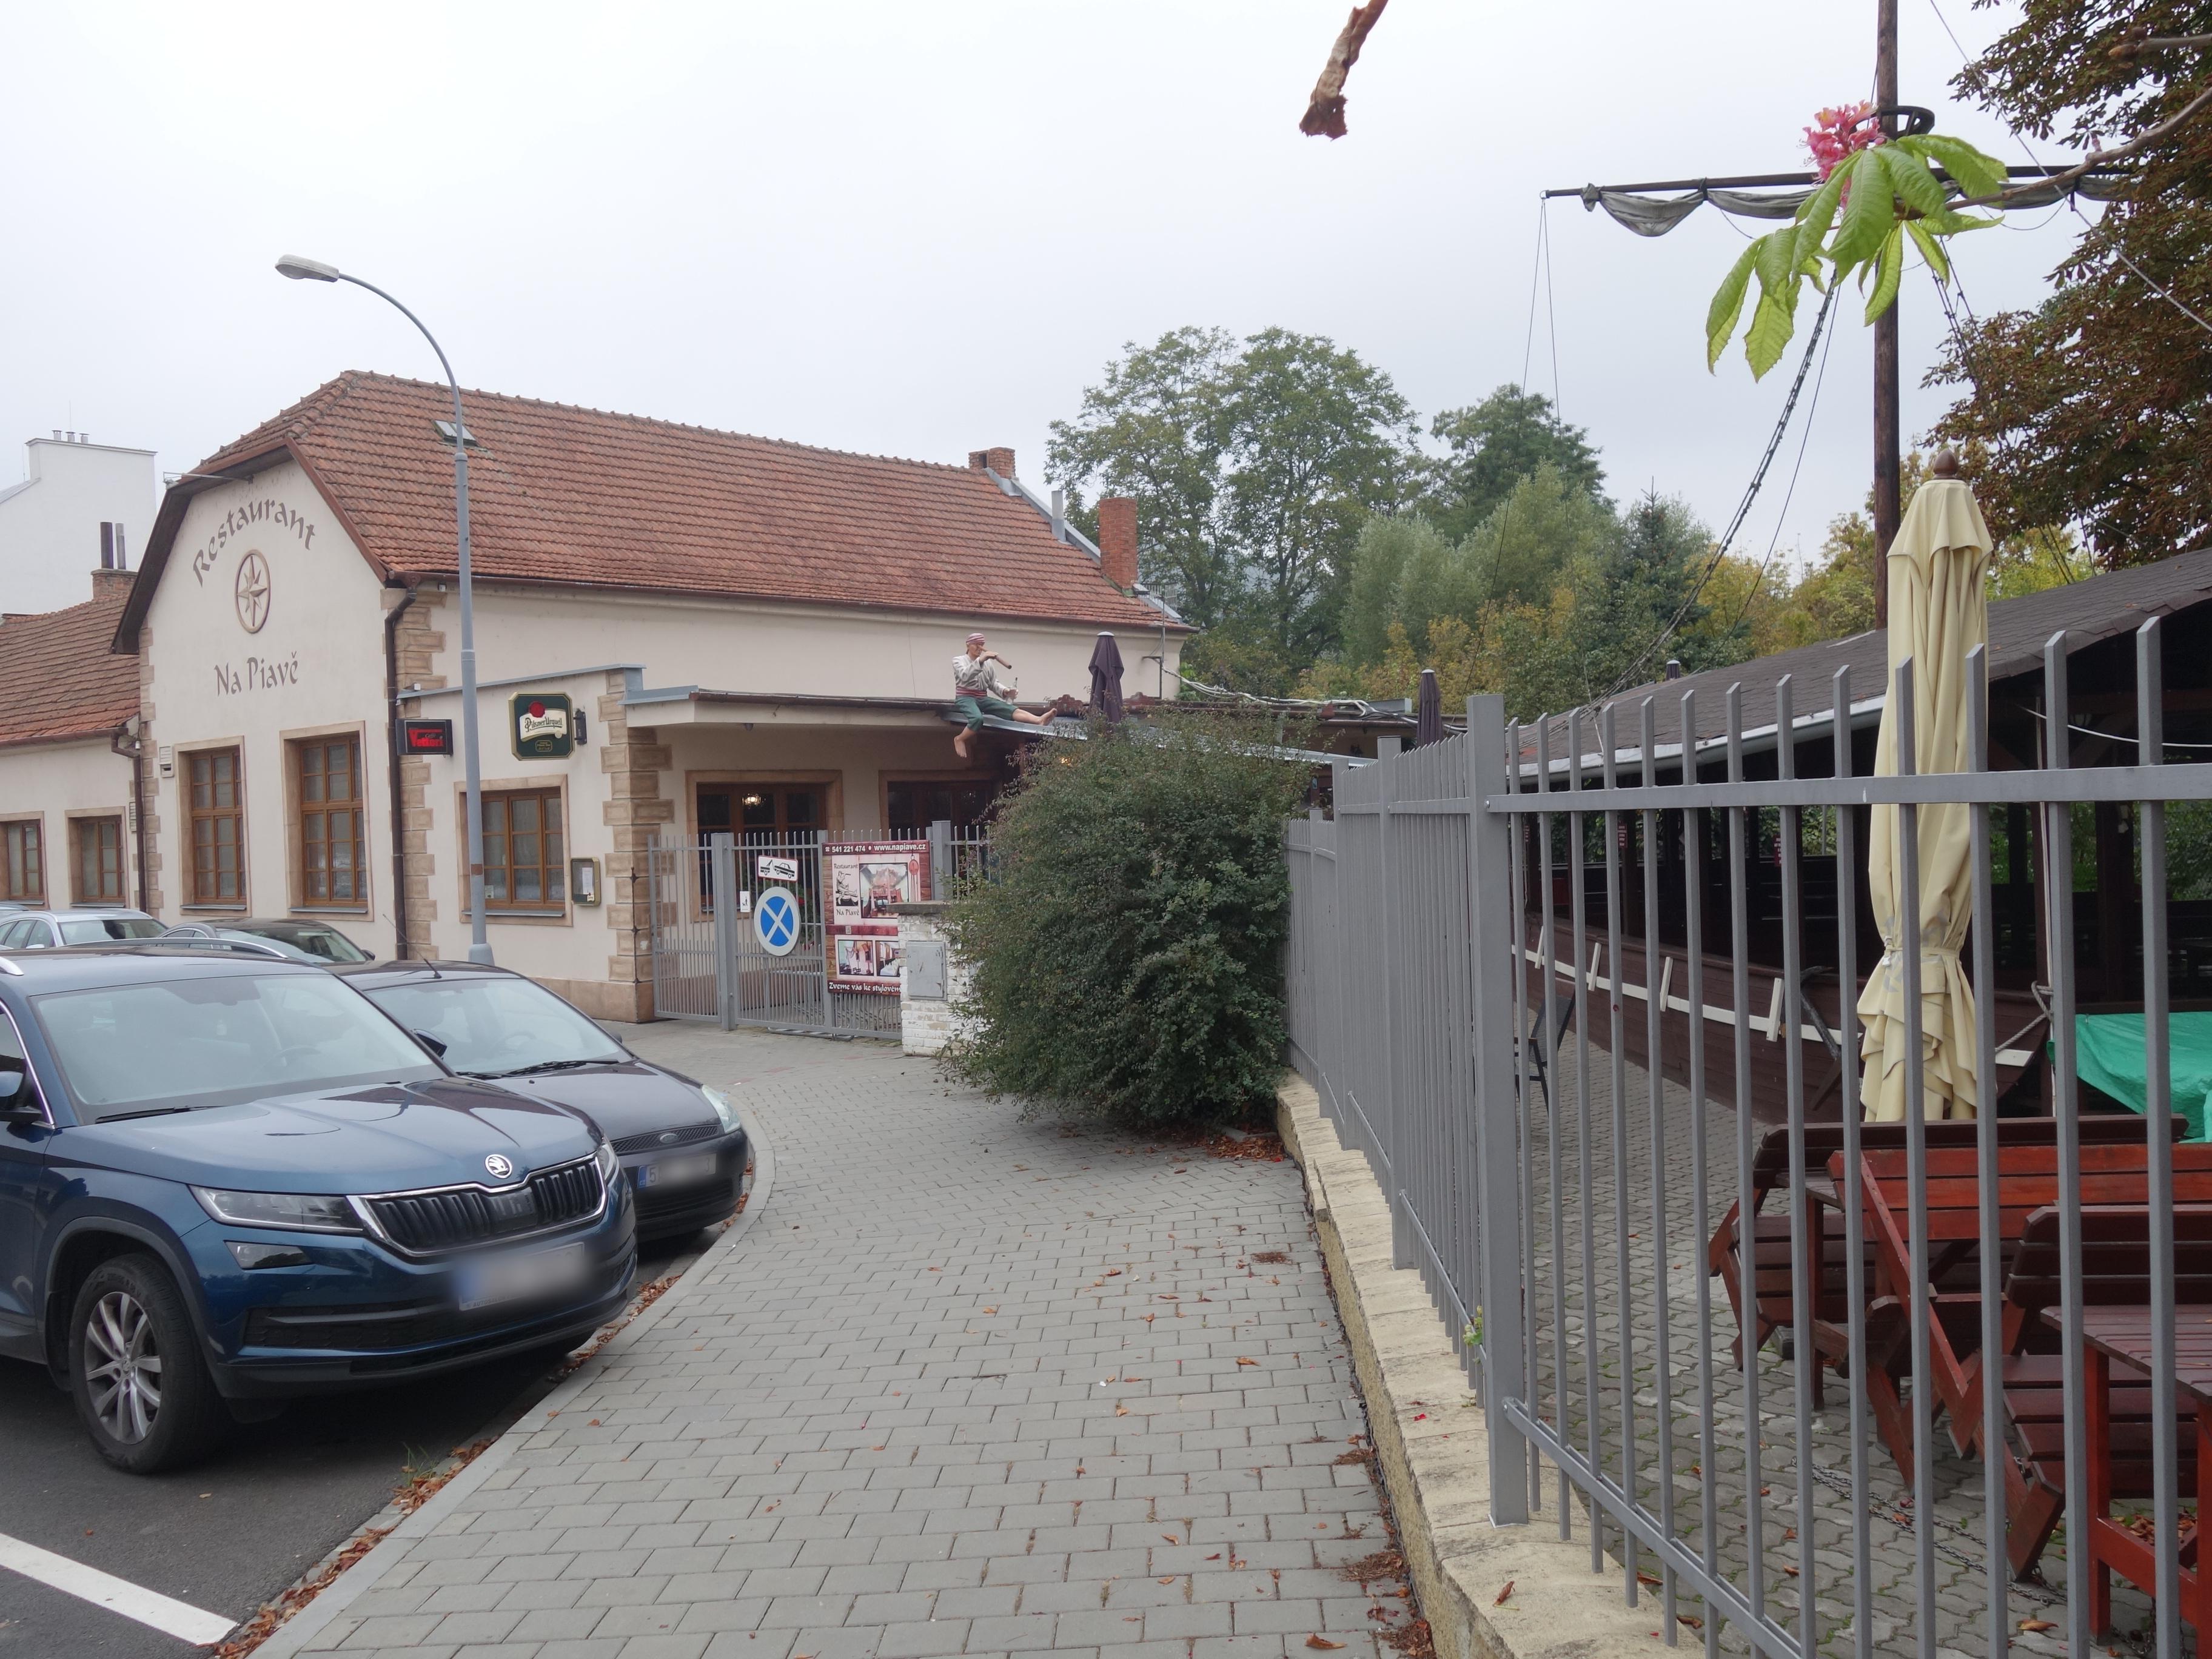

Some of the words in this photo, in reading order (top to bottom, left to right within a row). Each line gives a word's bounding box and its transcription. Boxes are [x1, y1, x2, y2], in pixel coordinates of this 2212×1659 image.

[193, 499, 315, 588] Restaurant
[213, 662, 242, 697] Na
[246, 651, 298, 691] Piavě
[524, 717, 547, 732] Pilsner
[545, 716, 563, 729] Urquell
[874, 843, 926, 852] www.napiave.cz
